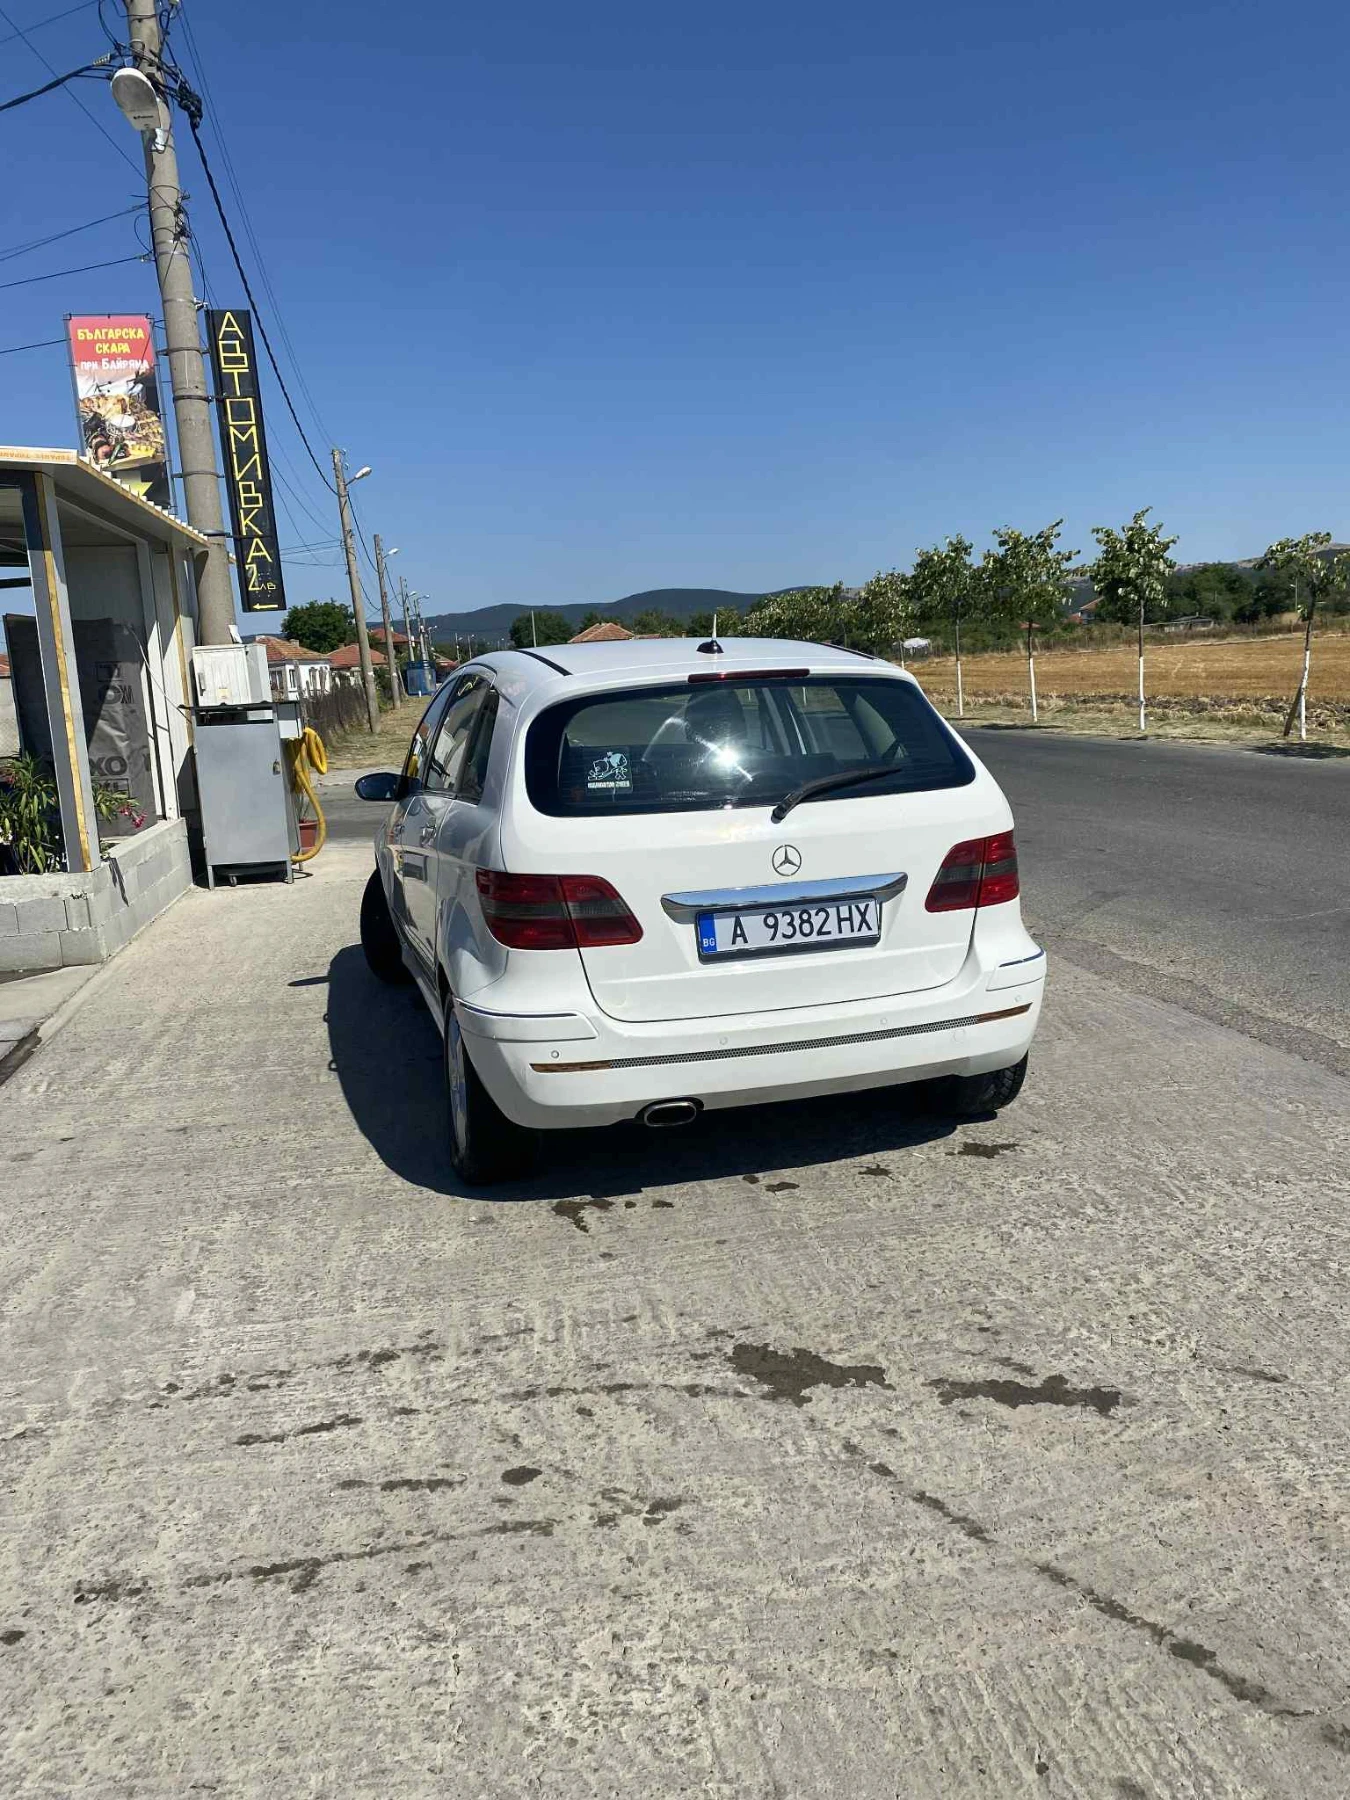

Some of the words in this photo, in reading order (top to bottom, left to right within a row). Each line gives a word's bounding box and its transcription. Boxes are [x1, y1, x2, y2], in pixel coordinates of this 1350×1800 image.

[77, 328, 145, 340] БЪЛГАРСКА
[95, 343, 132, 354] СКАРА
[218, 311, 273, 563] АВТОМИВКА
[731, 915, 749, 945] A
[702, 938, 716, 947] BG
